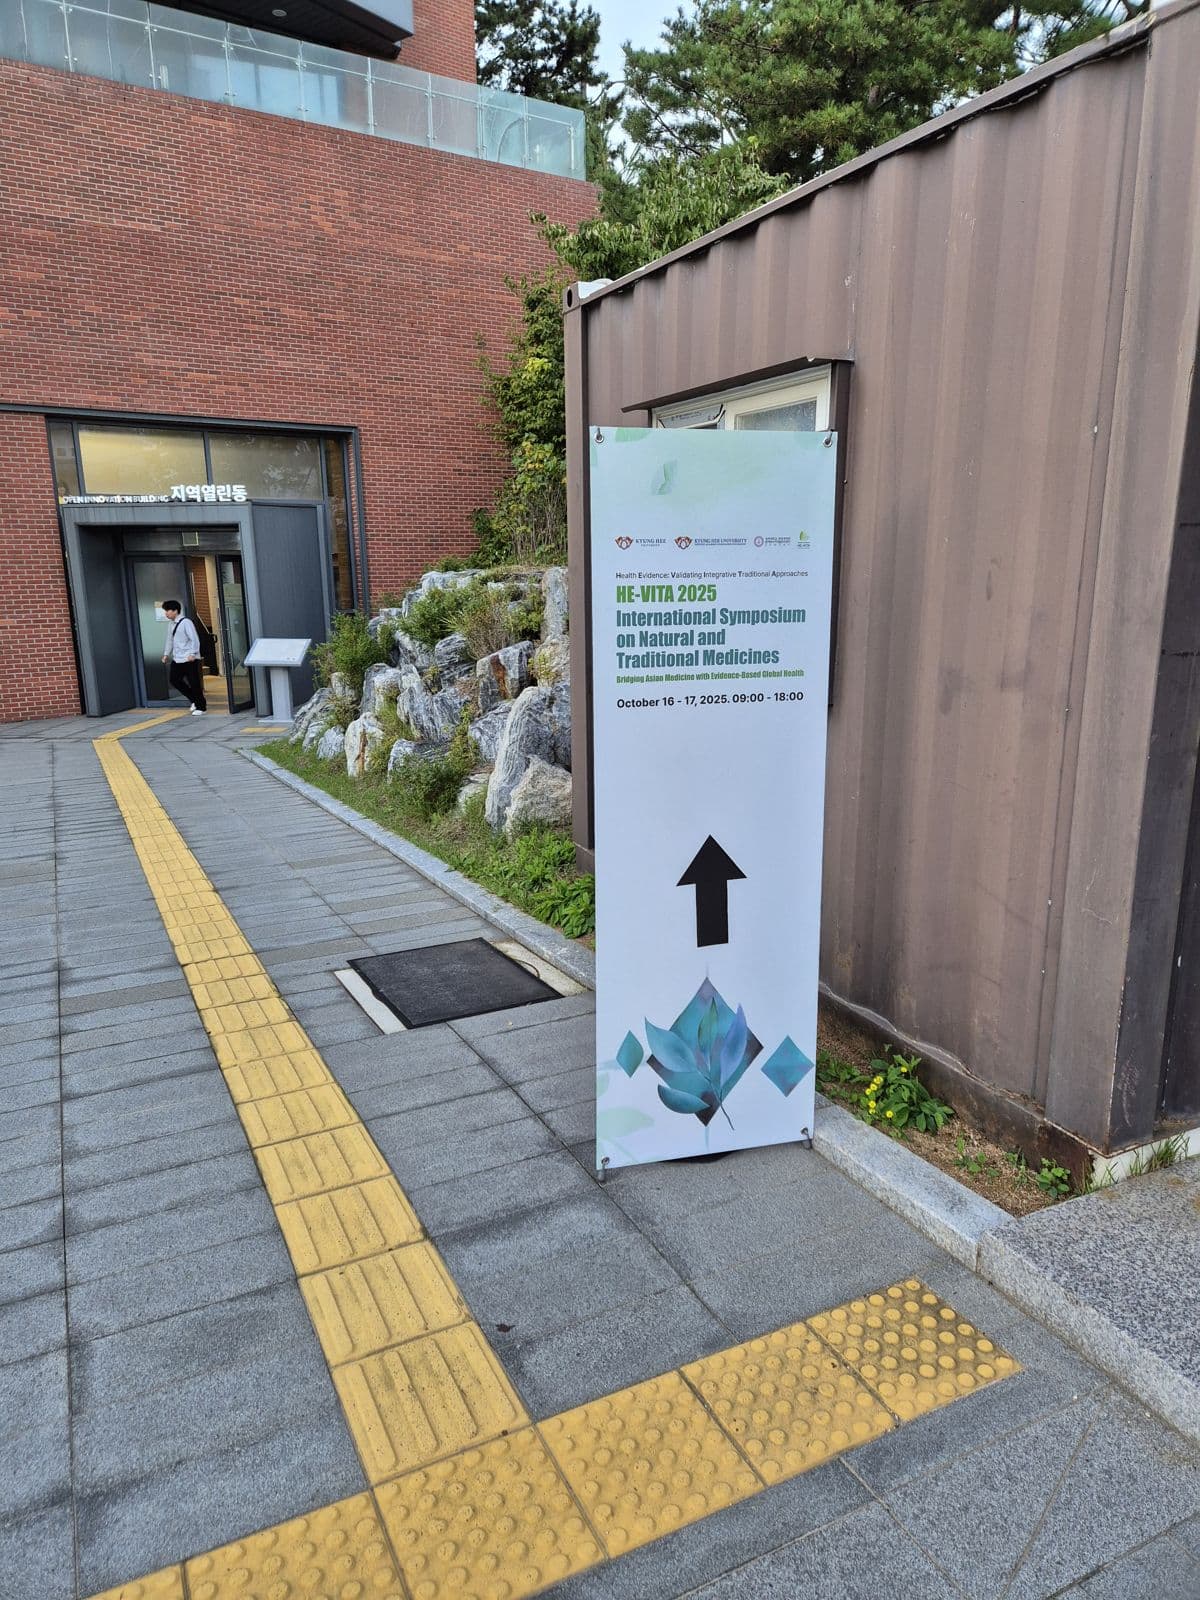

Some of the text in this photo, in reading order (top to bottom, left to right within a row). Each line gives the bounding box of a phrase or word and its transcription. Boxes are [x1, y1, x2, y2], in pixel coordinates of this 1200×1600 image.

[63, 495, 169, 504] OPEN INNOVATION BUILDING
[170, 484, 248, 503] 지역열린동
[671, 571, 702, 580] Validating
[703, 571, 737, 579] Integrative
[737, 570, 770, 578] Traditional
[771, 570, 808, 578] Approaches
[616, 584, 717, 603] HE-VITA 2025
[616, 607, 806, 627] International Symposium
[616, 629, 726, 648] on Natural and
[616, 649, 780, 669] Traditional Medicines
[616, 669, 805, 684] Bridging Asian Medicine with Evidence-Based Global Health
[617, 698, 660, 708] October
[662, 697, 675, 706] 16
[684, 695, 698, 707] 17,
[699, 694, 730, 705] 2025.
[732, 693, 764, 703] 09:00
[774, 692, 804, 702] 18:00
